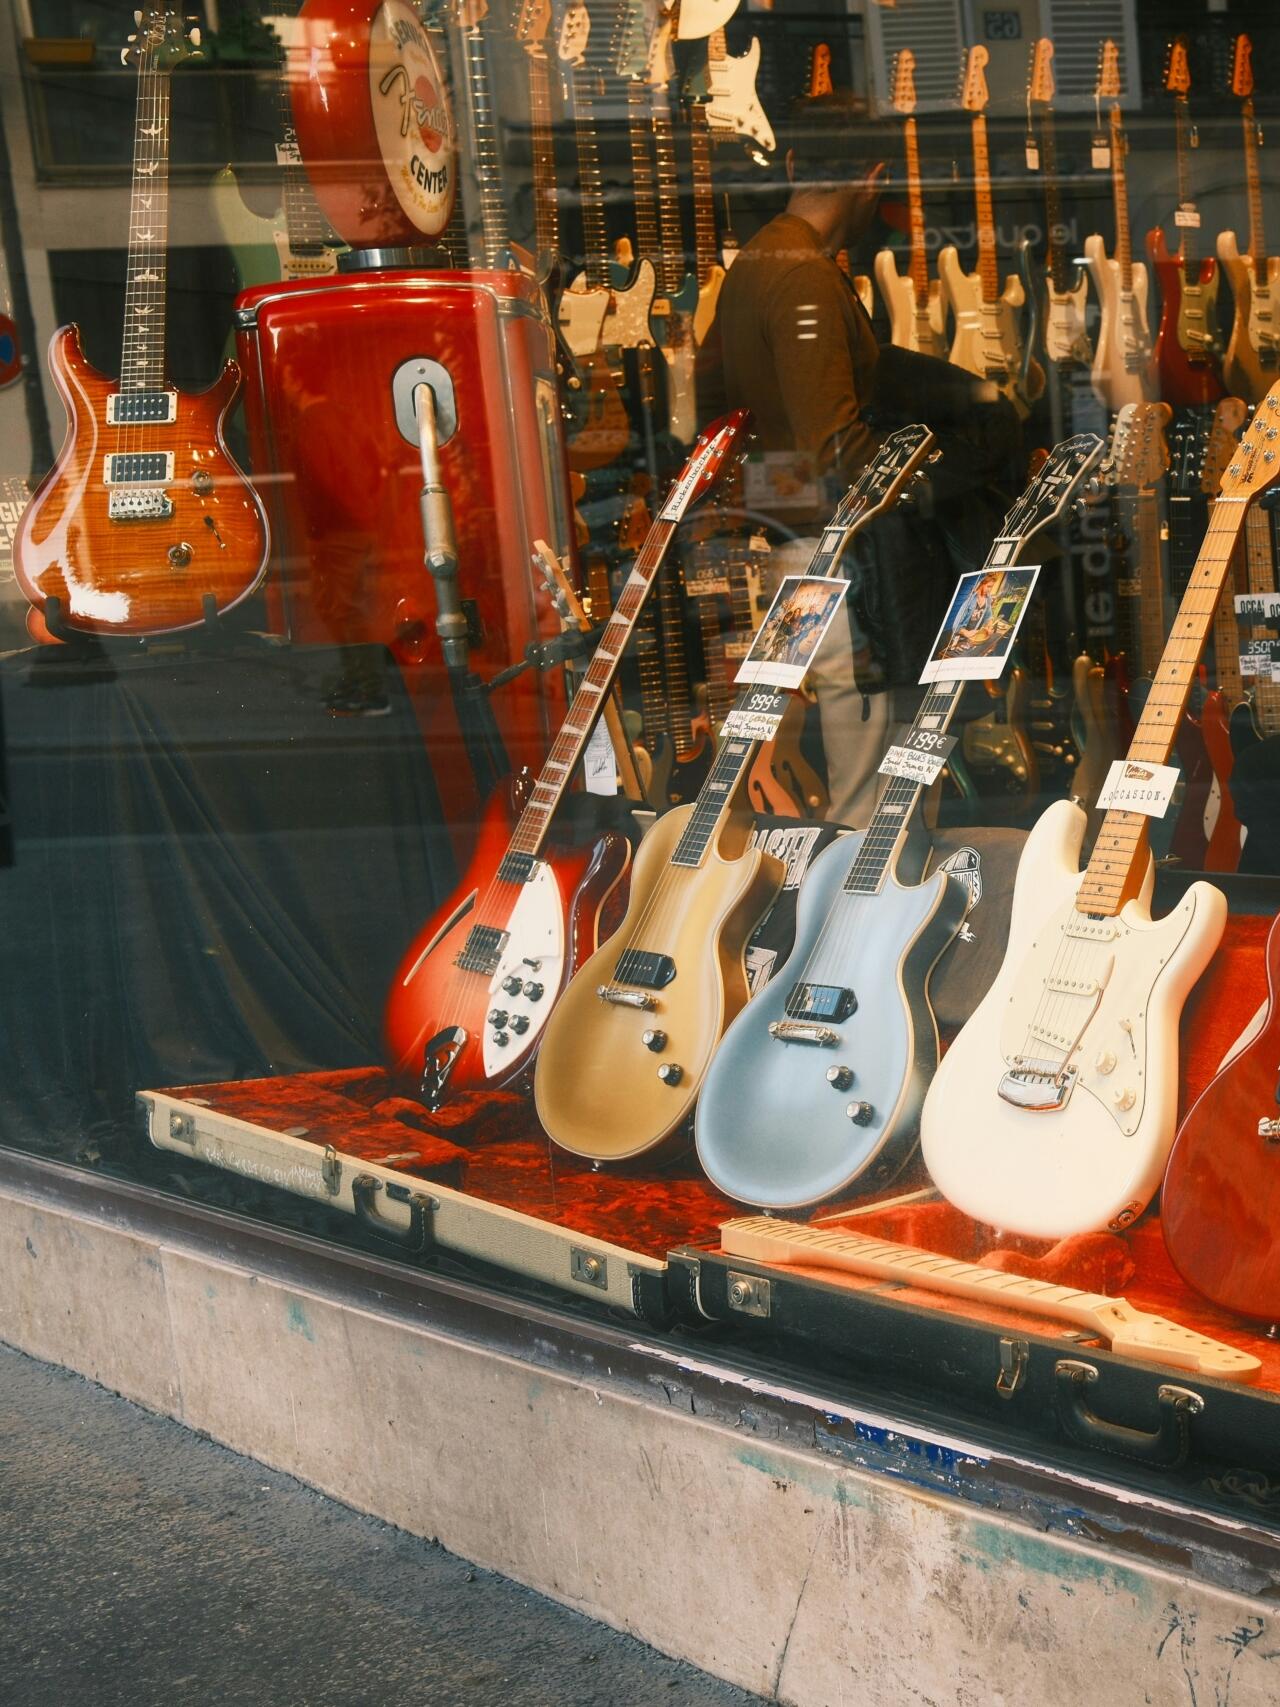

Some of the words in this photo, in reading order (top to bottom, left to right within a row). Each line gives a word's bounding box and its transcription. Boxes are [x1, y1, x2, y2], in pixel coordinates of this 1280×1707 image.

[410, 155, 448, 194] CENTER
[671, 443, 716, 511] Rickenbacker
[748, 694, 782, 711] 999€
